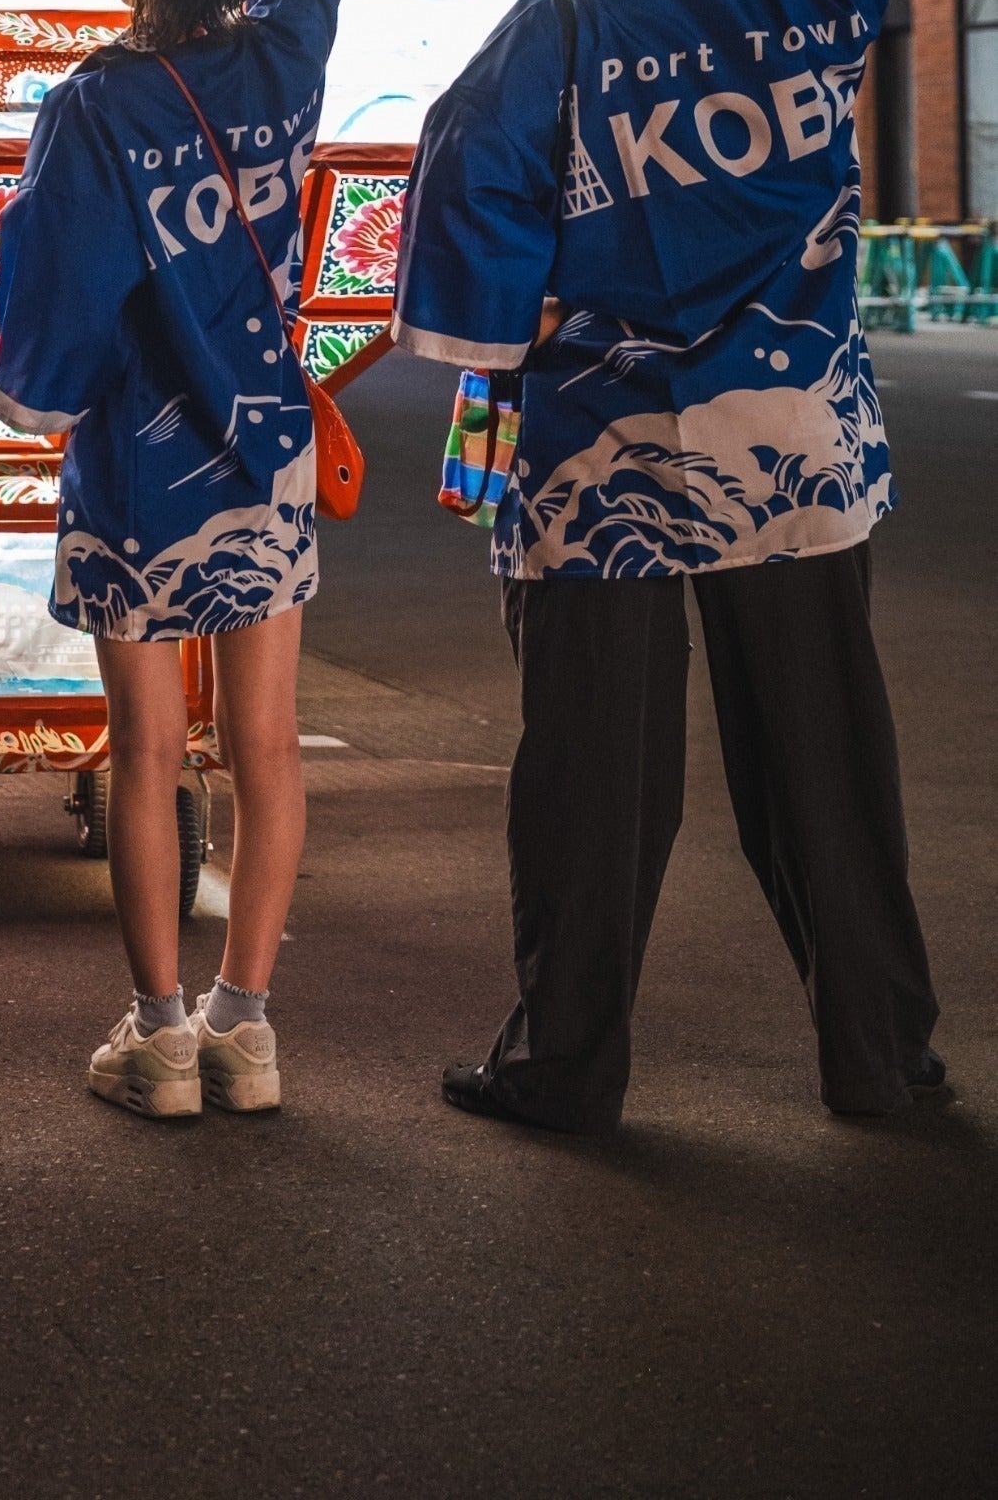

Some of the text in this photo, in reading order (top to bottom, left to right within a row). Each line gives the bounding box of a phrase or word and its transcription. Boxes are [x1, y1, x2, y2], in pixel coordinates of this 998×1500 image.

[602, 10, 869, 93] Port Town
[128, 134, 204, 170] ort
[609, 54, 865, 199] KOBE
